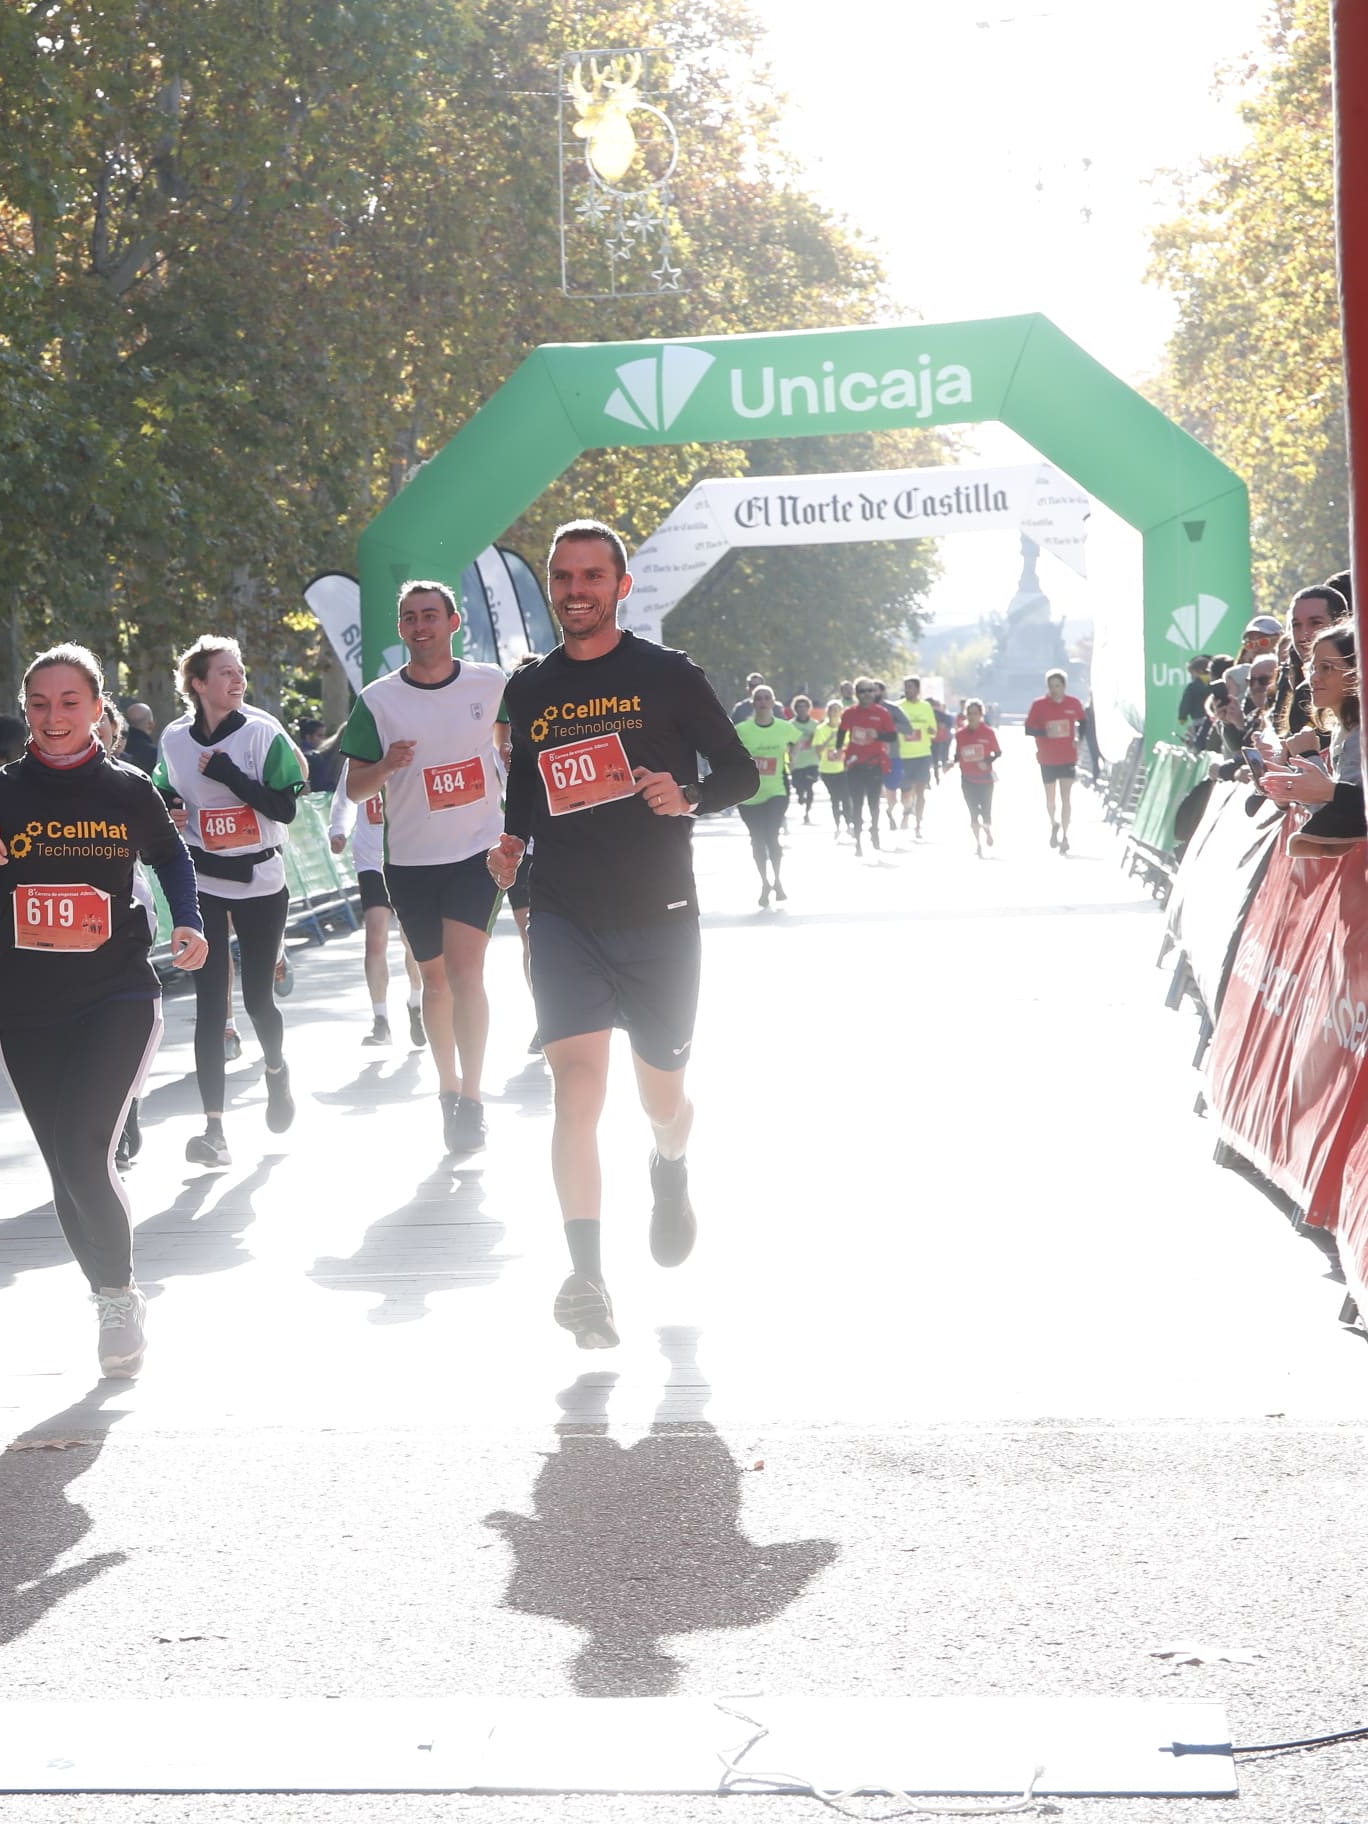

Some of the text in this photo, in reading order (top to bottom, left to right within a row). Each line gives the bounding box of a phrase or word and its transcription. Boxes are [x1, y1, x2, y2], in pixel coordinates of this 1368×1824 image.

[730, 354, 973, 418] Unicaja
[734, 483, 1009, 528] El Norte de Castilla
[562, 696, 641, 719] CellMat
[552, 717, 643, 738] Technologies
[433, 771, 465, 794] 484
[551, 754, 597, 789] 620
[47, 821, 128, 840] CellMat
[205, 816, 236, 837] 486
[36, 842, 130, 859] Technologies
[27, 898, 74, 927] 619
